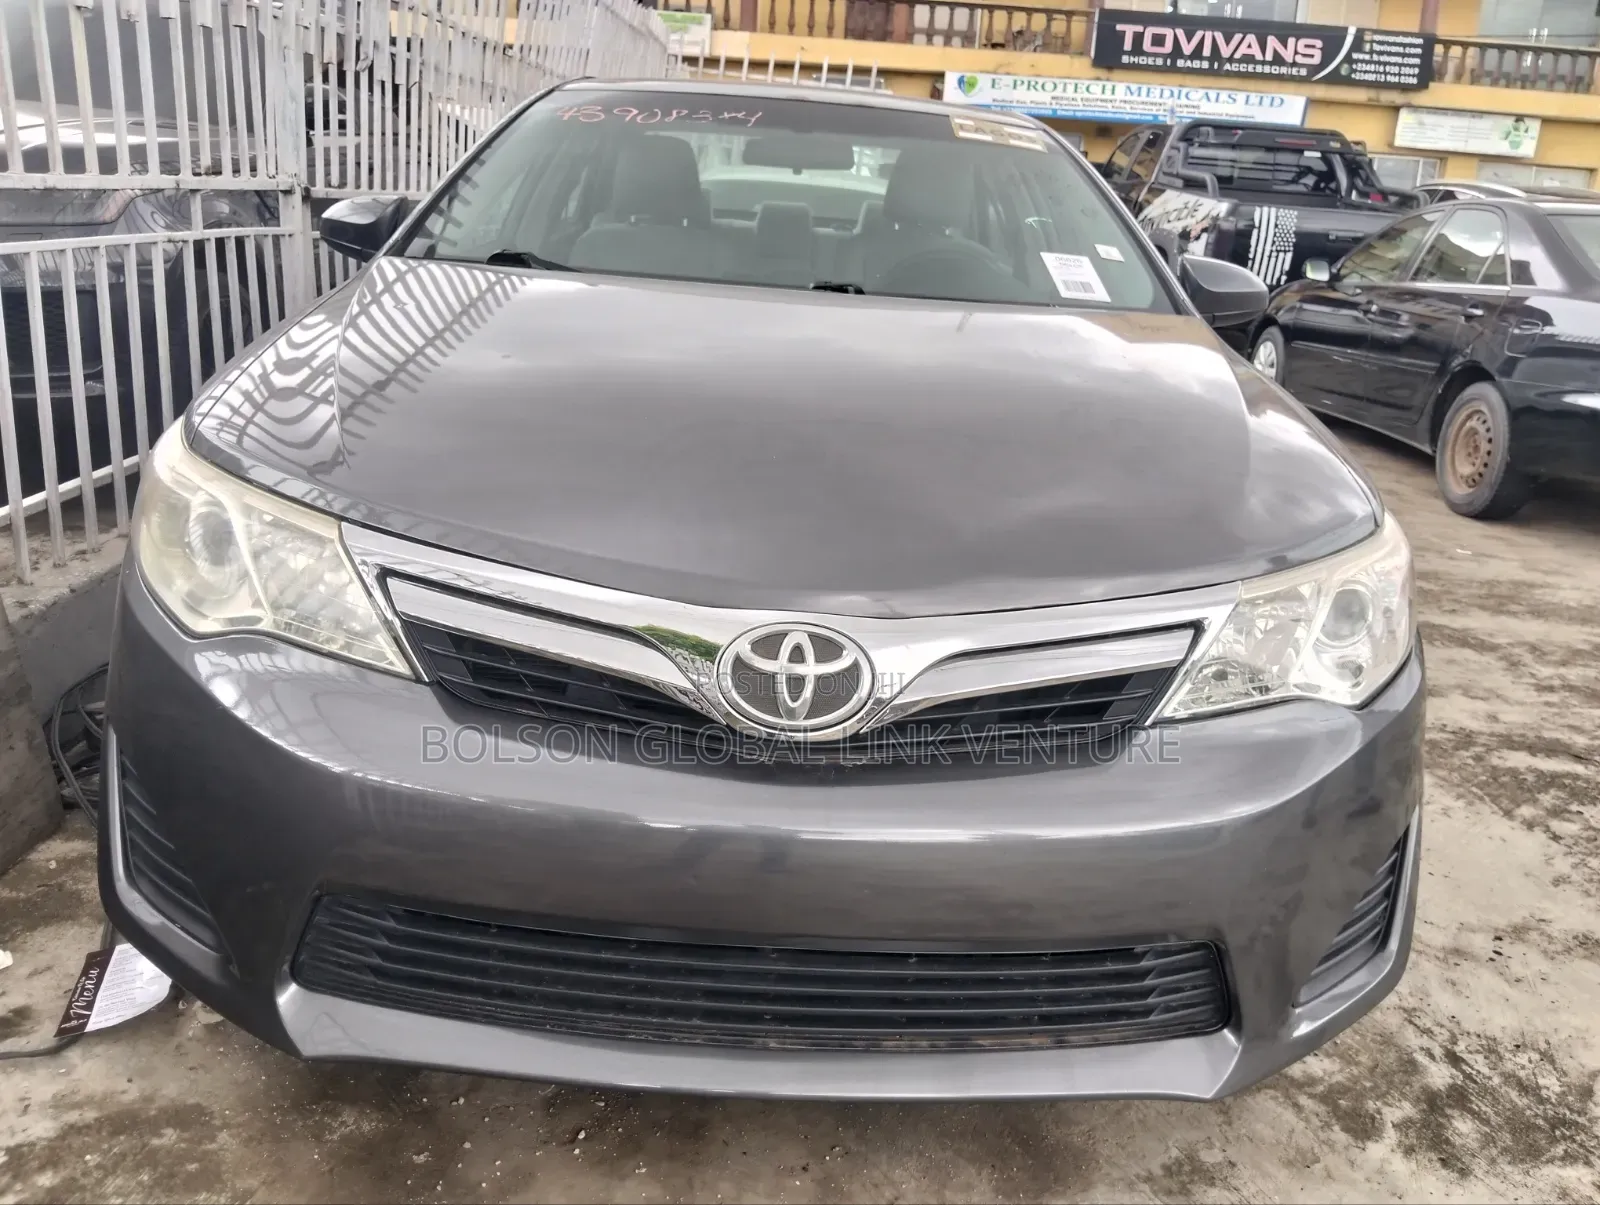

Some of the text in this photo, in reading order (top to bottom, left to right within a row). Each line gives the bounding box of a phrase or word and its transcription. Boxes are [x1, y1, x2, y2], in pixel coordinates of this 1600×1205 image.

[1115, 24, 1323, 66] TOVIVANS
[1121, 55, 1164, 66] SHOES
[1176, 58, 1210, 69] BAGS
[1223, 61, 1308, 76] ACCESSORIES
[990, 77, 1286, 109] E-PROTECH MEDICALS LTD
[1051, 95, 1079, 103] MEDICAL
[70, 966, 100, 1018] Menu
